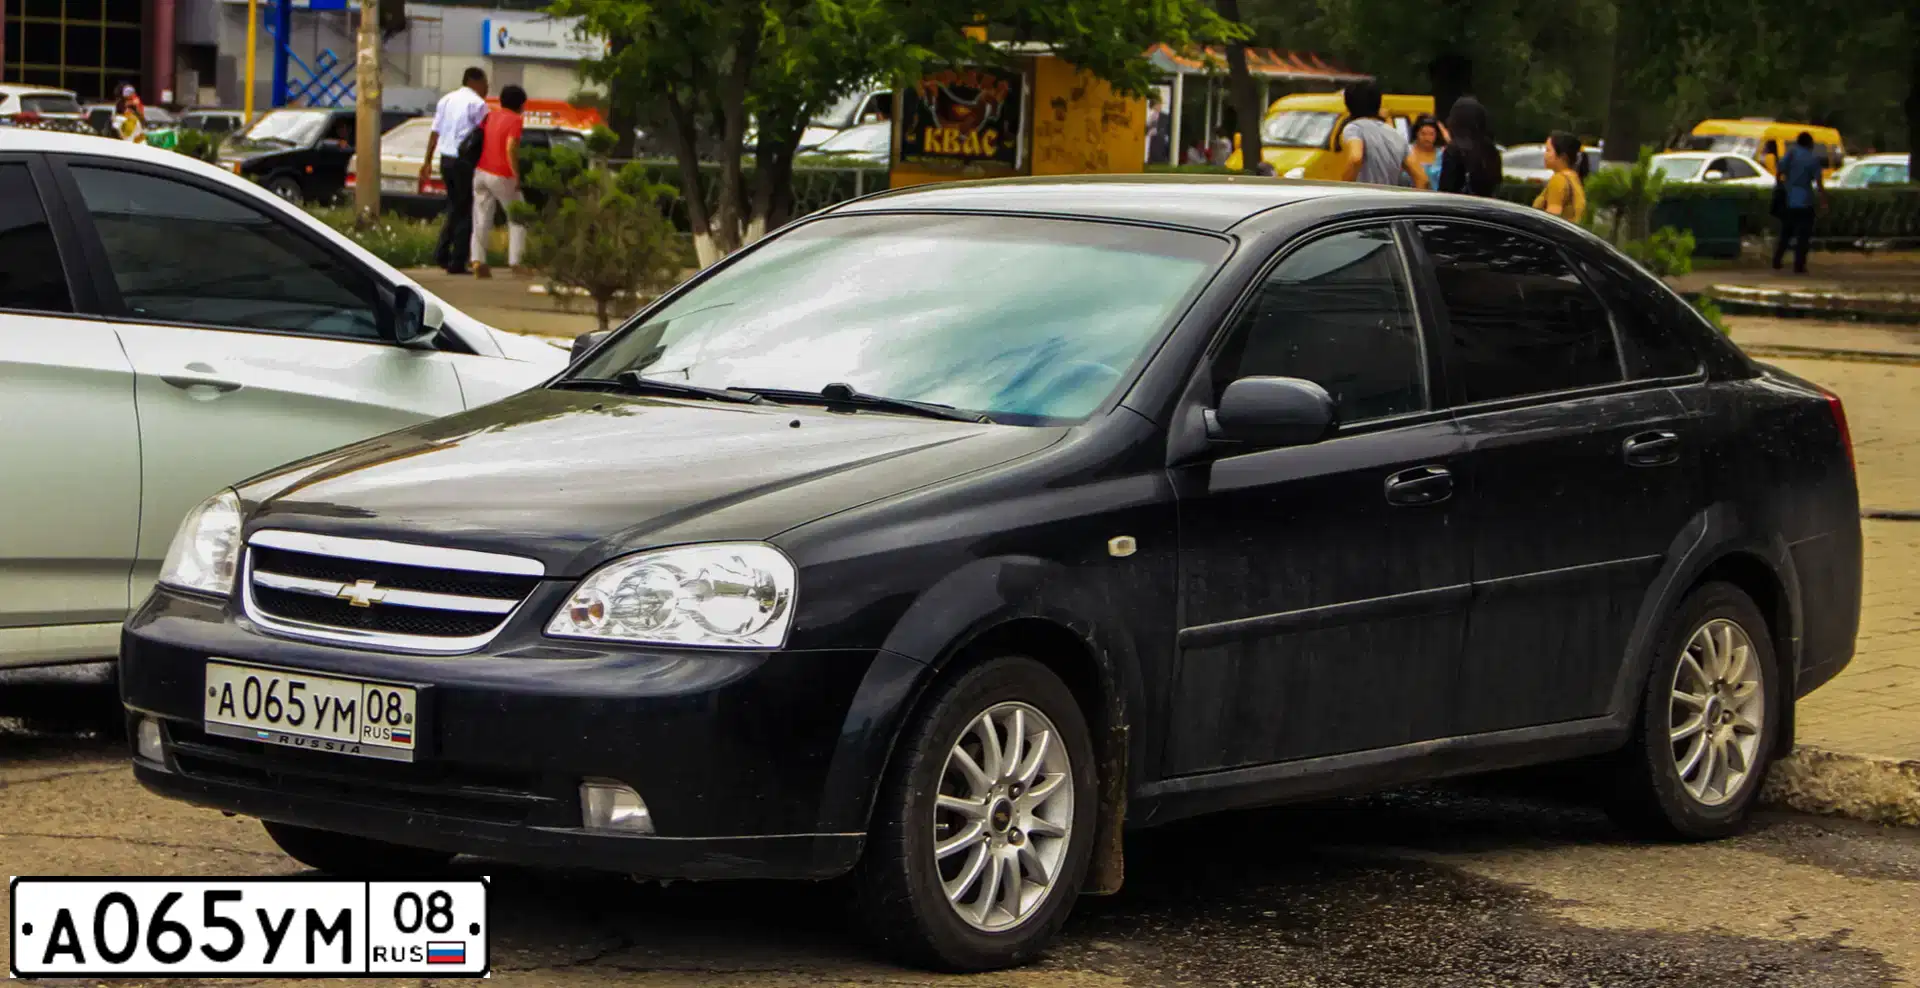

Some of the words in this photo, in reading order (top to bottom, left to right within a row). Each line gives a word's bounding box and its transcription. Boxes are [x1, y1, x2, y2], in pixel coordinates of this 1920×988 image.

[366, 688, 402, 726] 08
[363, 725, 390, 740] RUS
[279, 735, 361, 754] RUSSIA
